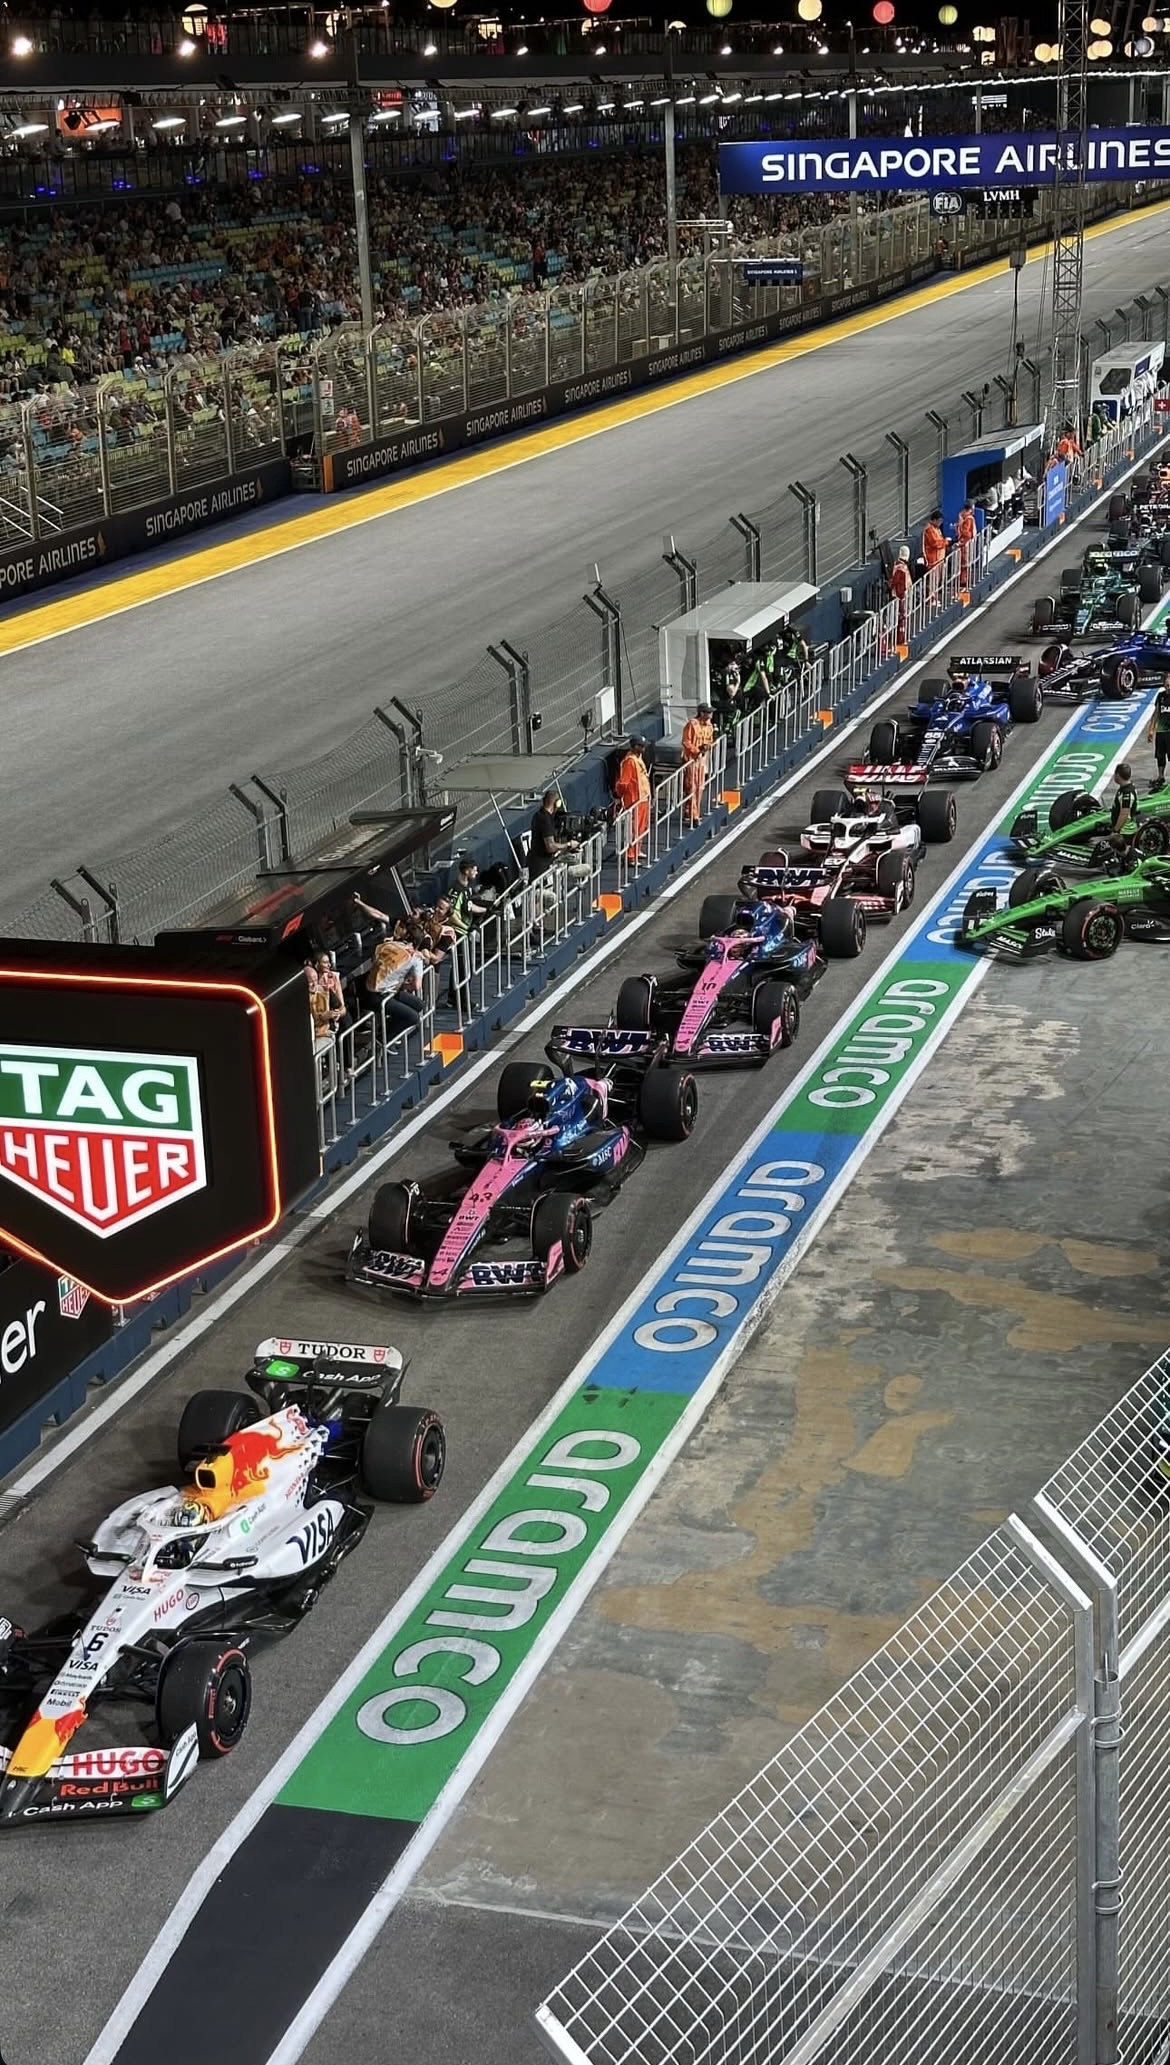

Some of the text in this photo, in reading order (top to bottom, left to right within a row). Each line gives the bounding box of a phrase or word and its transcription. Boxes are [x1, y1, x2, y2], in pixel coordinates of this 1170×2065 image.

[762, 147, 980, 182] SINGAPORE
[934, 194, 959, 211] FIA
[984, 189, 1020, 201] LVMH
[466, 399, 543, 437] SINGAPORE AIRLINES
[347, 433, 439, 477] SINGAPORE AIRLINES
[145, 482, 256, 536] SINGAPORE AIRLINES
[38, 536, 96, 575] AIRLINES
[959, 657, 1012, 665] ATLASSIAN
[566, 1028, 650, 1054] BWT
[808, 979, 950, 1108] aramco
[0, 1060, 179, 1124] TAG
[3, 1131, 190, 1222] HEUER
[633, 1160, 826, 1352] aramco
[472, 1263, 546, 1286] BWT
[298, 1343, 366, 1360] TUDOR
[302, 1370, 382, 1385] Csh App
[285, 1507, 334, 1565] VISA
[122, 1585, 152, 1595] VISA
[356, 1430, 641, 1745] aramco
[153, 1588, 184, 1622] HUGO
[90, 1624, 122, 1633] TUDOR
[87, 1632, 109, 1652] 6
[69, 1660, 99, 1671] VISA
[46, 1698, 72, 1708] Mobil
[73, 1750, 164, 1777] HUGO
[60, 1779, 159, 1797] Red Bull
[23, 1800, 124, 1818] Cash App
